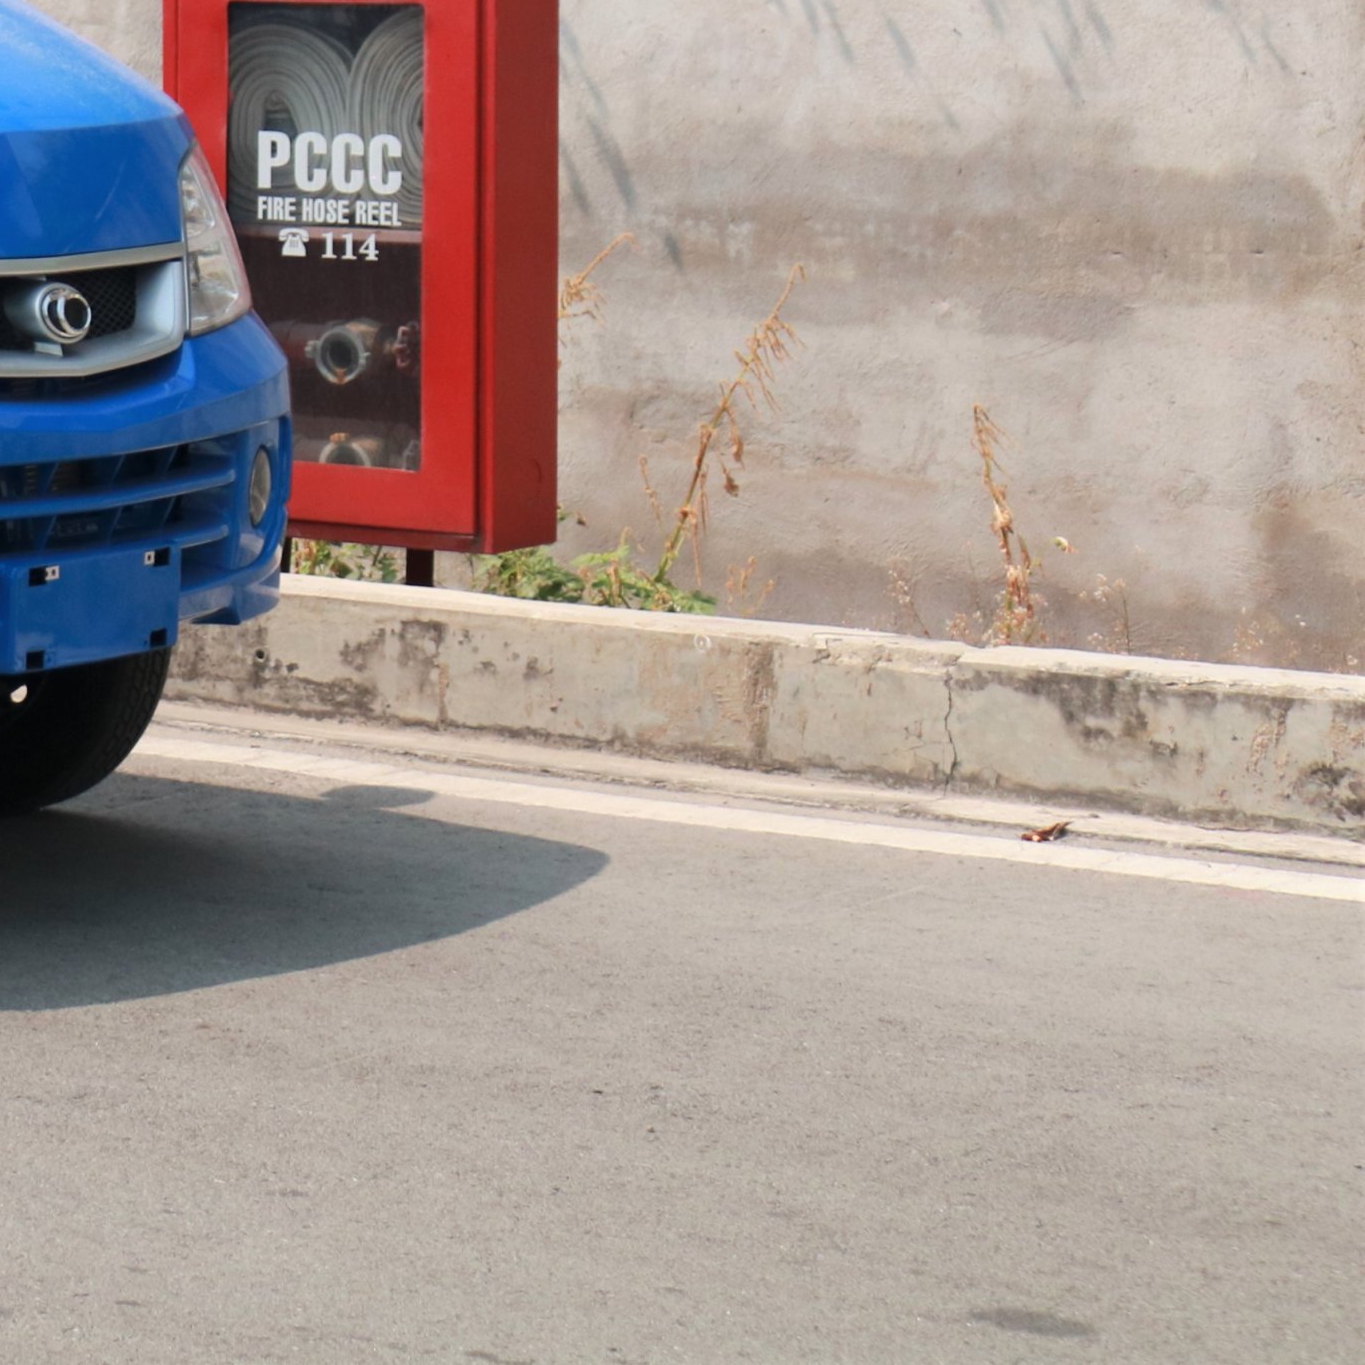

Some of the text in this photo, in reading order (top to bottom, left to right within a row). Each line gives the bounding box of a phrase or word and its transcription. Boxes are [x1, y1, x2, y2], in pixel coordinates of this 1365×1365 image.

[257, 130, 403, 196] PCCC
[257, 195, 402, 227] FIRE HOSE REEL
[321, 232, 380, 262] 114
